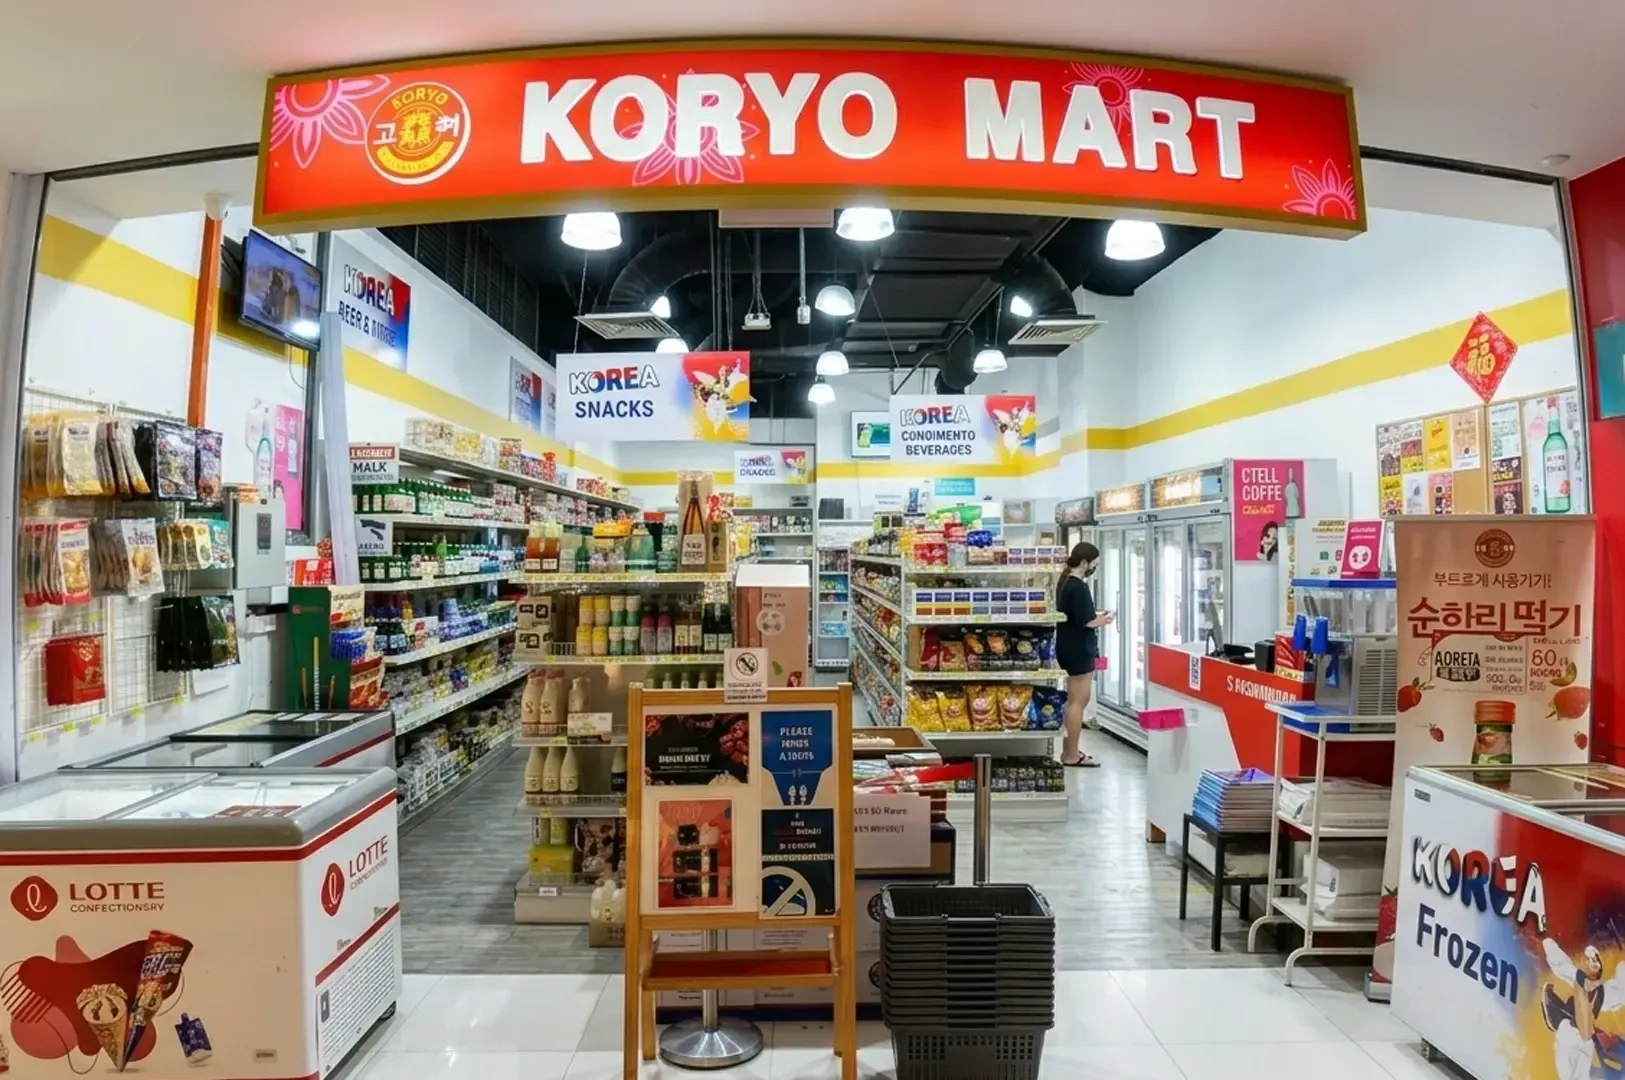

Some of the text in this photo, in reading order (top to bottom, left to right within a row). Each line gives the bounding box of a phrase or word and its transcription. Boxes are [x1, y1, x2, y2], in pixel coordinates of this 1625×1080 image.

[391, 87, 449, 109] KORYO
[520, 71, 1256, 180] KORYO MART
[343, 263, 396, 317] KOREA
[569, 364, 660, 395] KOREA
[575, 400, 654, 418] SNACKS
[900, 404, 971, 427] KOREA
[1434, 650, 1481, 668] AORETA
[349, 834, 388, 878] LOTTE
[69, 881, 165, 901] LOTTE
[1411, 837, 1547, 935] KOREA
[1416, 902, 1519, 1005] Frozen
